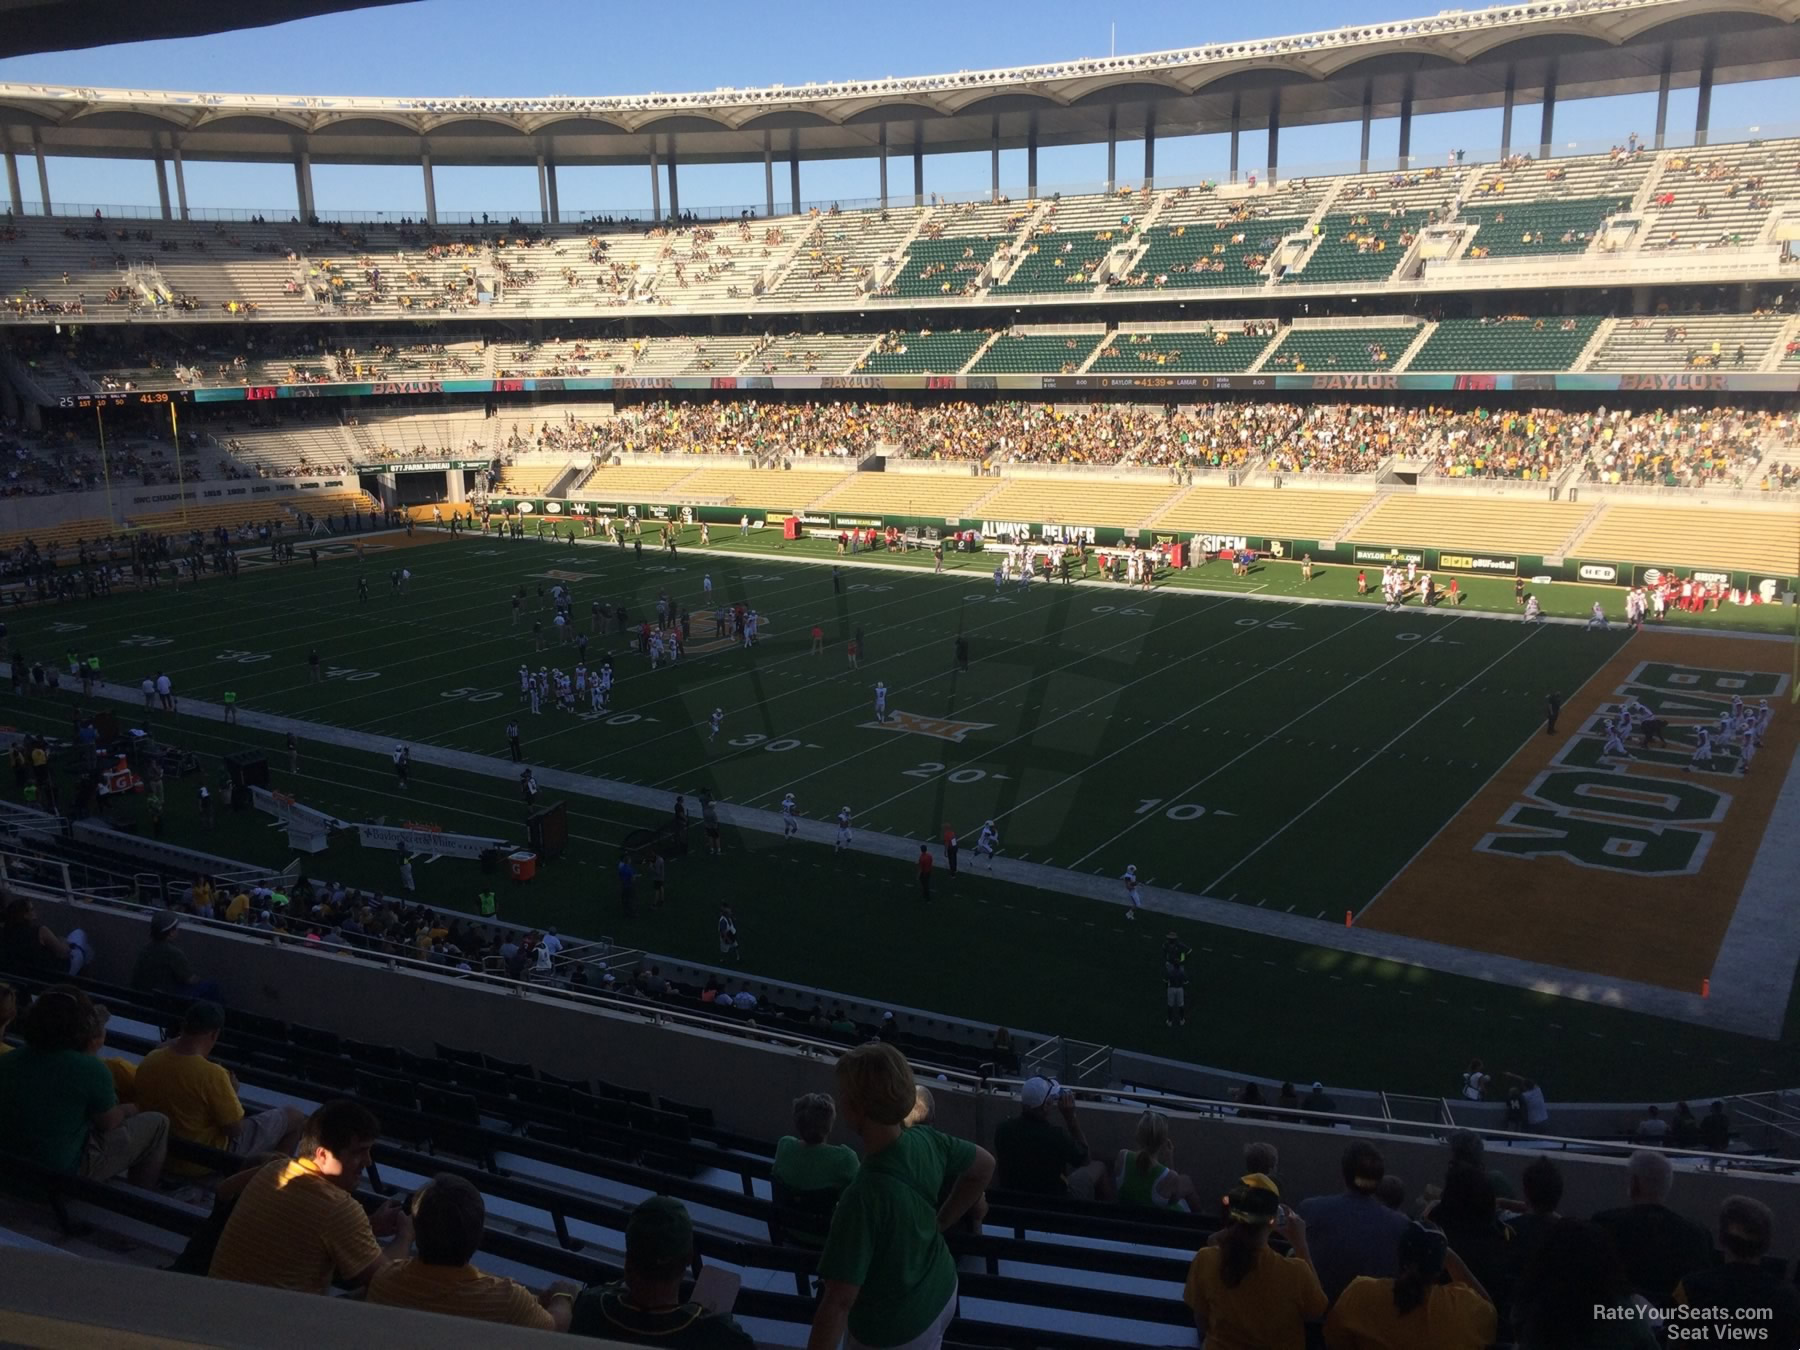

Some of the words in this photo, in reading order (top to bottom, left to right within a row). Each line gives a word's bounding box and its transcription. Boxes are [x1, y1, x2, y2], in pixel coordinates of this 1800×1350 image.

[371, 381, 443, 395] BAYLOR
[611, 377, 675, 389] BAYLOR
[821, 377, 884, 389] BAYLOR
[1102, 379, 1108, 387] 0
[1141, 378, 1166, 387] 41:39
[1202, 378, 1209, 387] 0
[1312, 375, 1398, 391] BAYLOR
[1618, 374, 1728, 391] BAYLOR
[60, 397, 74, 407] 25
[140, 393, 169, 403] 41:39
[981, 520, 1030, 540] ALWAYS
[1041, 524, 1096, 544] DELIVER
[1190, 534, 1247, 552] #SICEM
[1472, 557, 1516, 570] @BUFootball
[215, 649, 273, 663] 30
[439, 686, 504, 702] 50
[727, 732, 800, 752] 30
[901, 761, 987, 784] 20
[1133, 797, 1206, 822] 10
[511, 863, 521, 875] G
